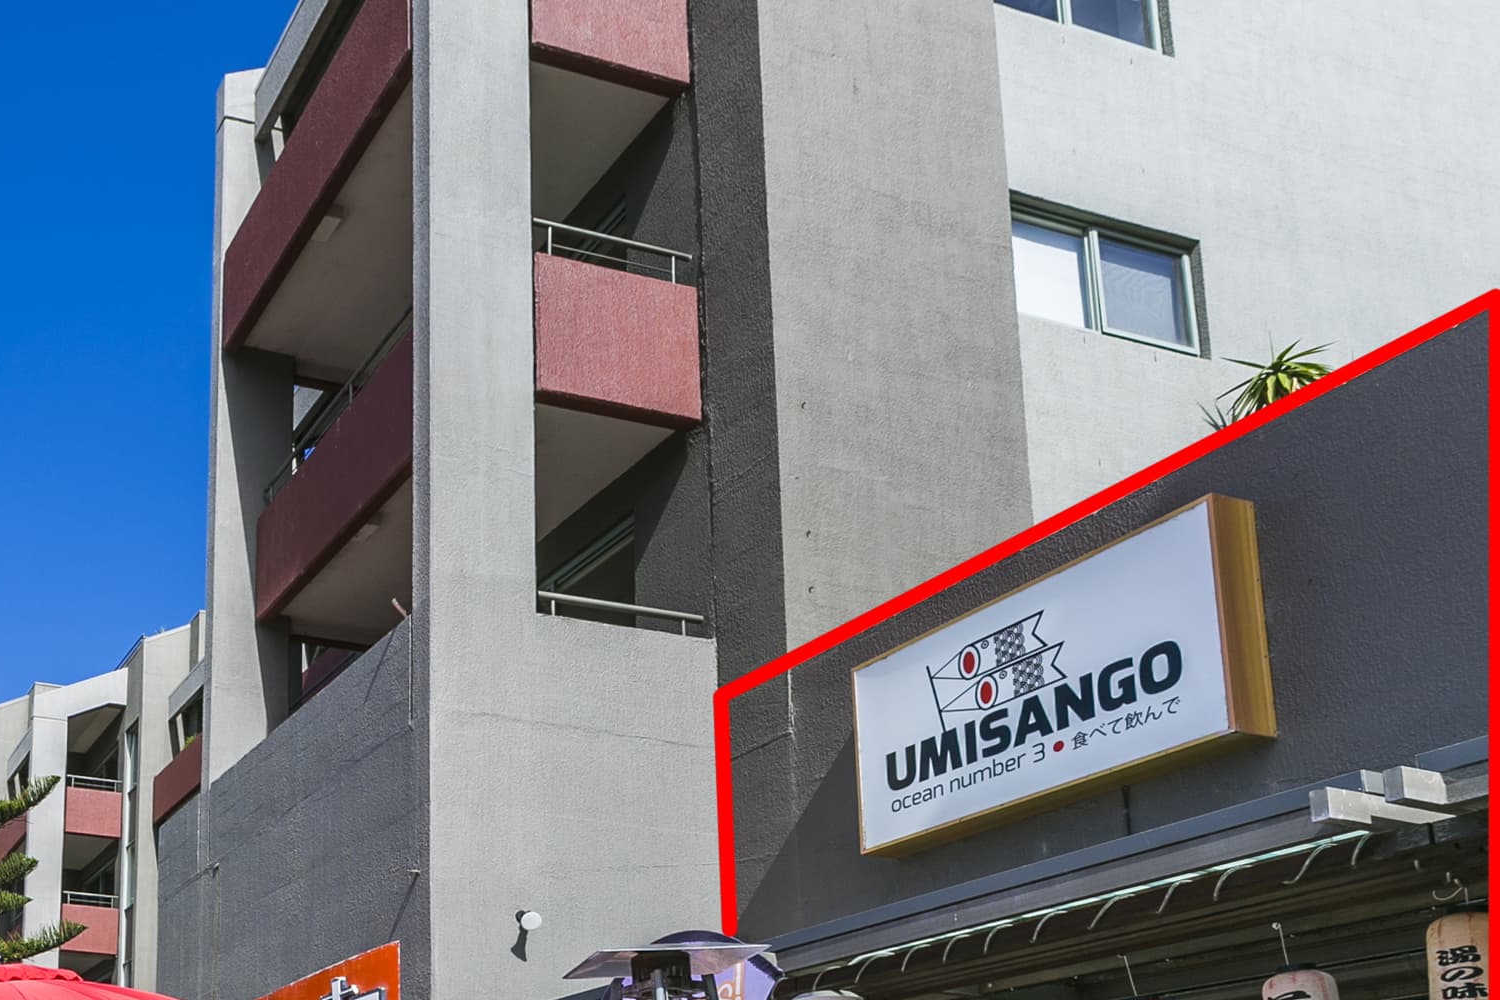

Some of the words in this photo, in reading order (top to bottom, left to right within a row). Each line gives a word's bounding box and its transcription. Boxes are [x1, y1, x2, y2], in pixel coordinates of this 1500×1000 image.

[886, 640, 1182, 791] UMISANGO
[1071, 696, 1181, 751] 食べて飲んで
[891, 783, 945, 813] ocean
[950, 753, 1027, 794] number
[1032, 743, 1046, 764] 3
